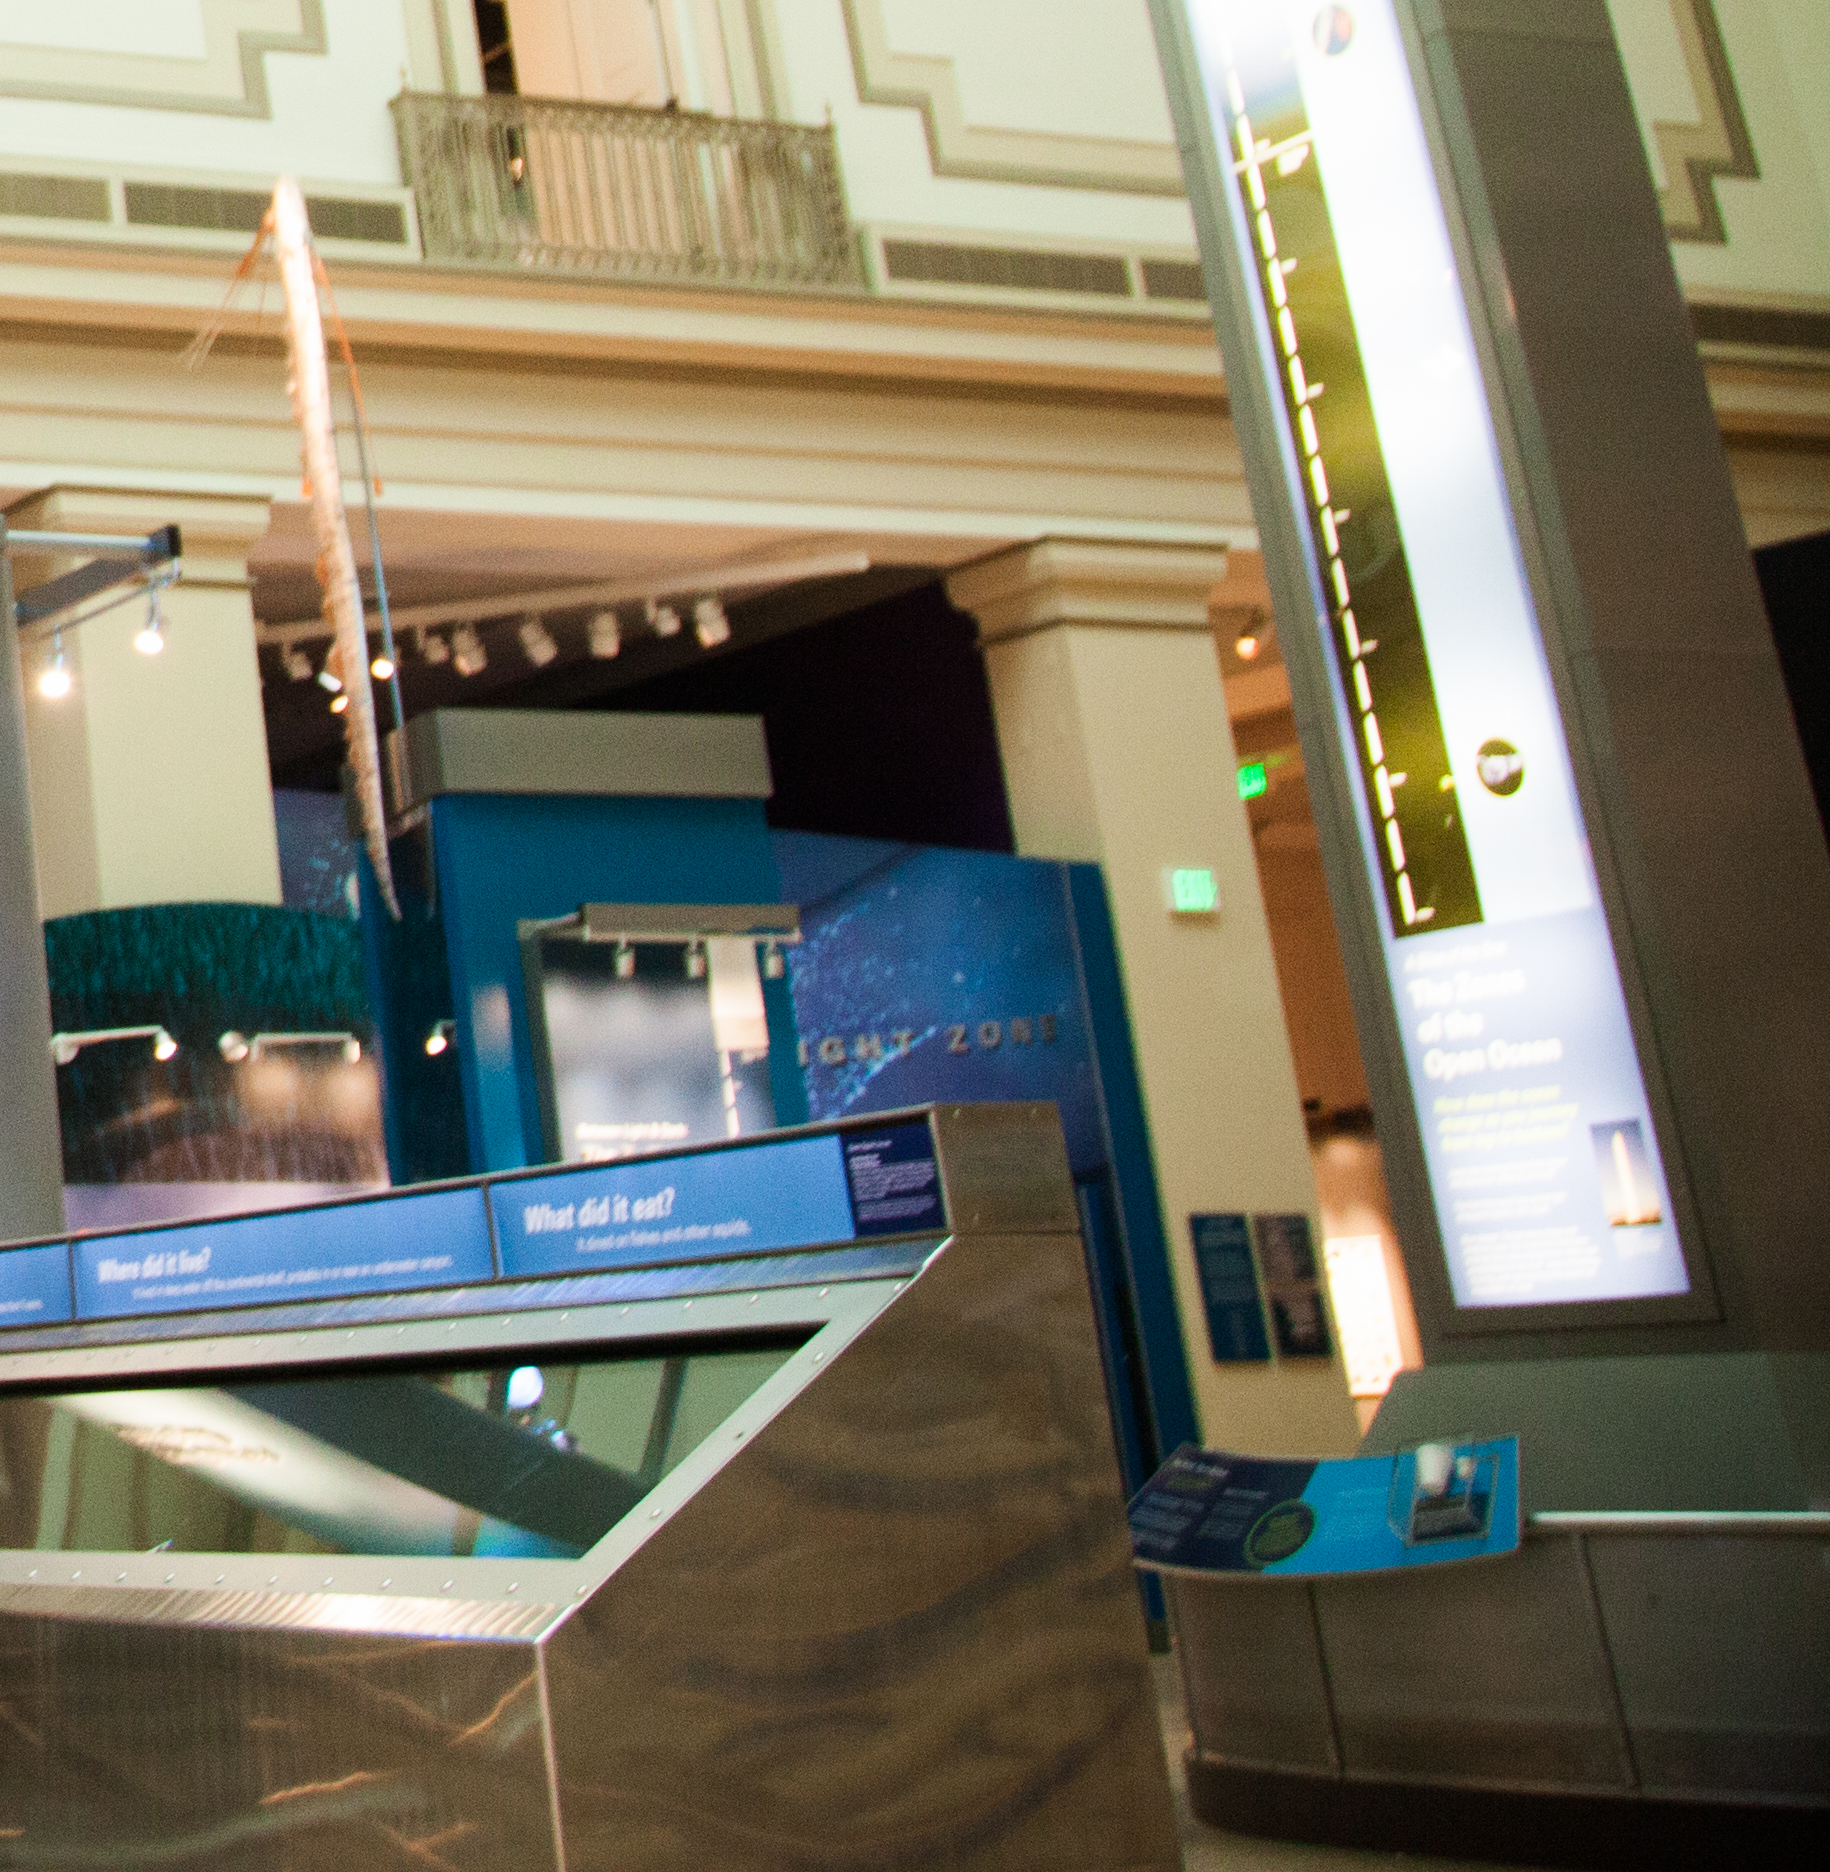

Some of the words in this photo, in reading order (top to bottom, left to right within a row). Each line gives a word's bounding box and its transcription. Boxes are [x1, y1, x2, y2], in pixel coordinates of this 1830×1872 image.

[1407, 977, 1453, 1009] The
[1416, 1012, 1443, 1044] of
[1444, 1008, 1484, 1040] the
[796, 1027, 915, 1069] IGHT
[1423, 1048, 1486, 1083] Open
[1487, 1037, 1563, 1071] Ocean
[524, 1203, 575, 1235] What
[578, 1196, 610, 1228] did
[613, 1194, 629, 1224] it
[632, 1187, 676, 1222] eat?
[98, 1259, 139, 1283] Where
[142, 1253, 163, 1279] did
[166, 1251, 176, 1274] it
[178, 1247, 212, 1274] live?
